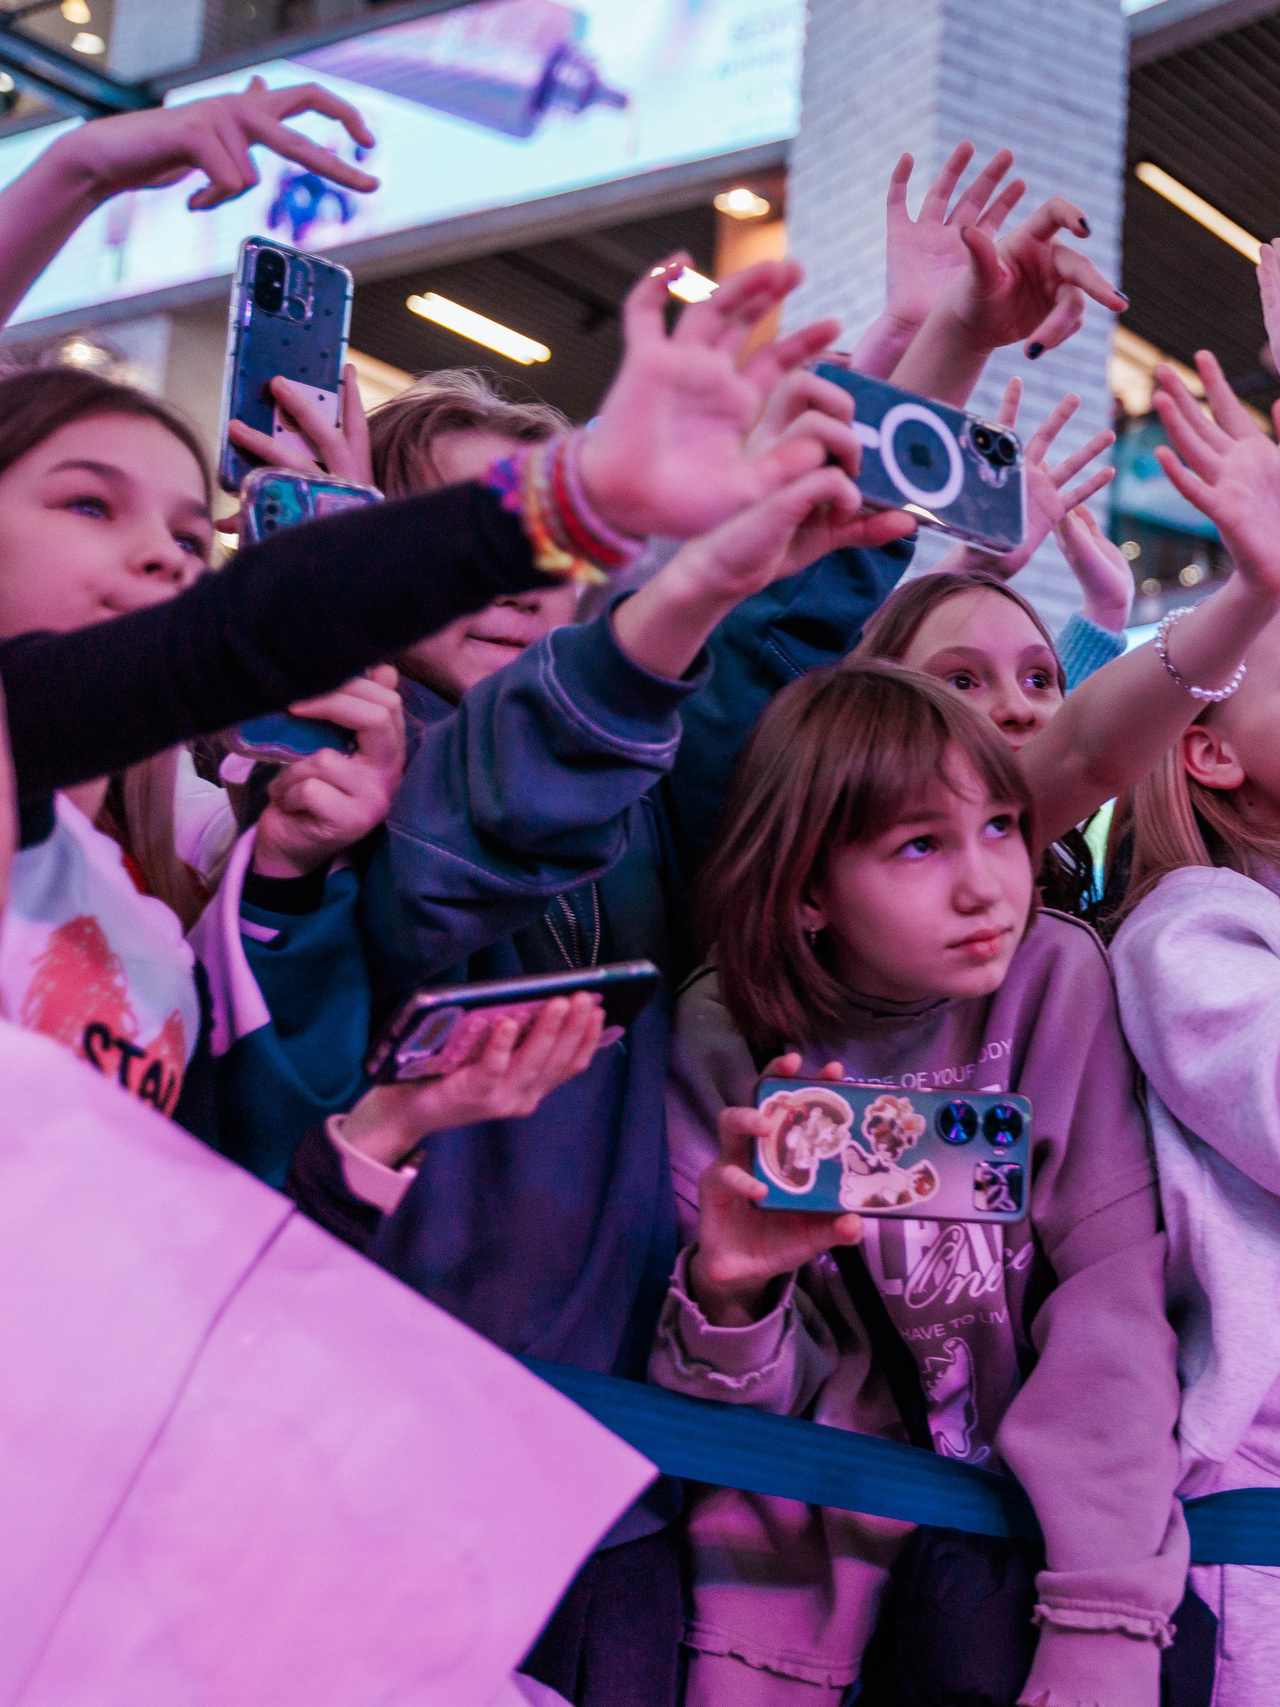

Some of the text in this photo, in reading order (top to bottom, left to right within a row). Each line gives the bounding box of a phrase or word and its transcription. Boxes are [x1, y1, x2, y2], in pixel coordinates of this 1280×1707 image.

[84, 1022, 175, 1112] STA
[948, 1312, 975, 1329] TO
[977, 1306, 1008, 1325] LIV
